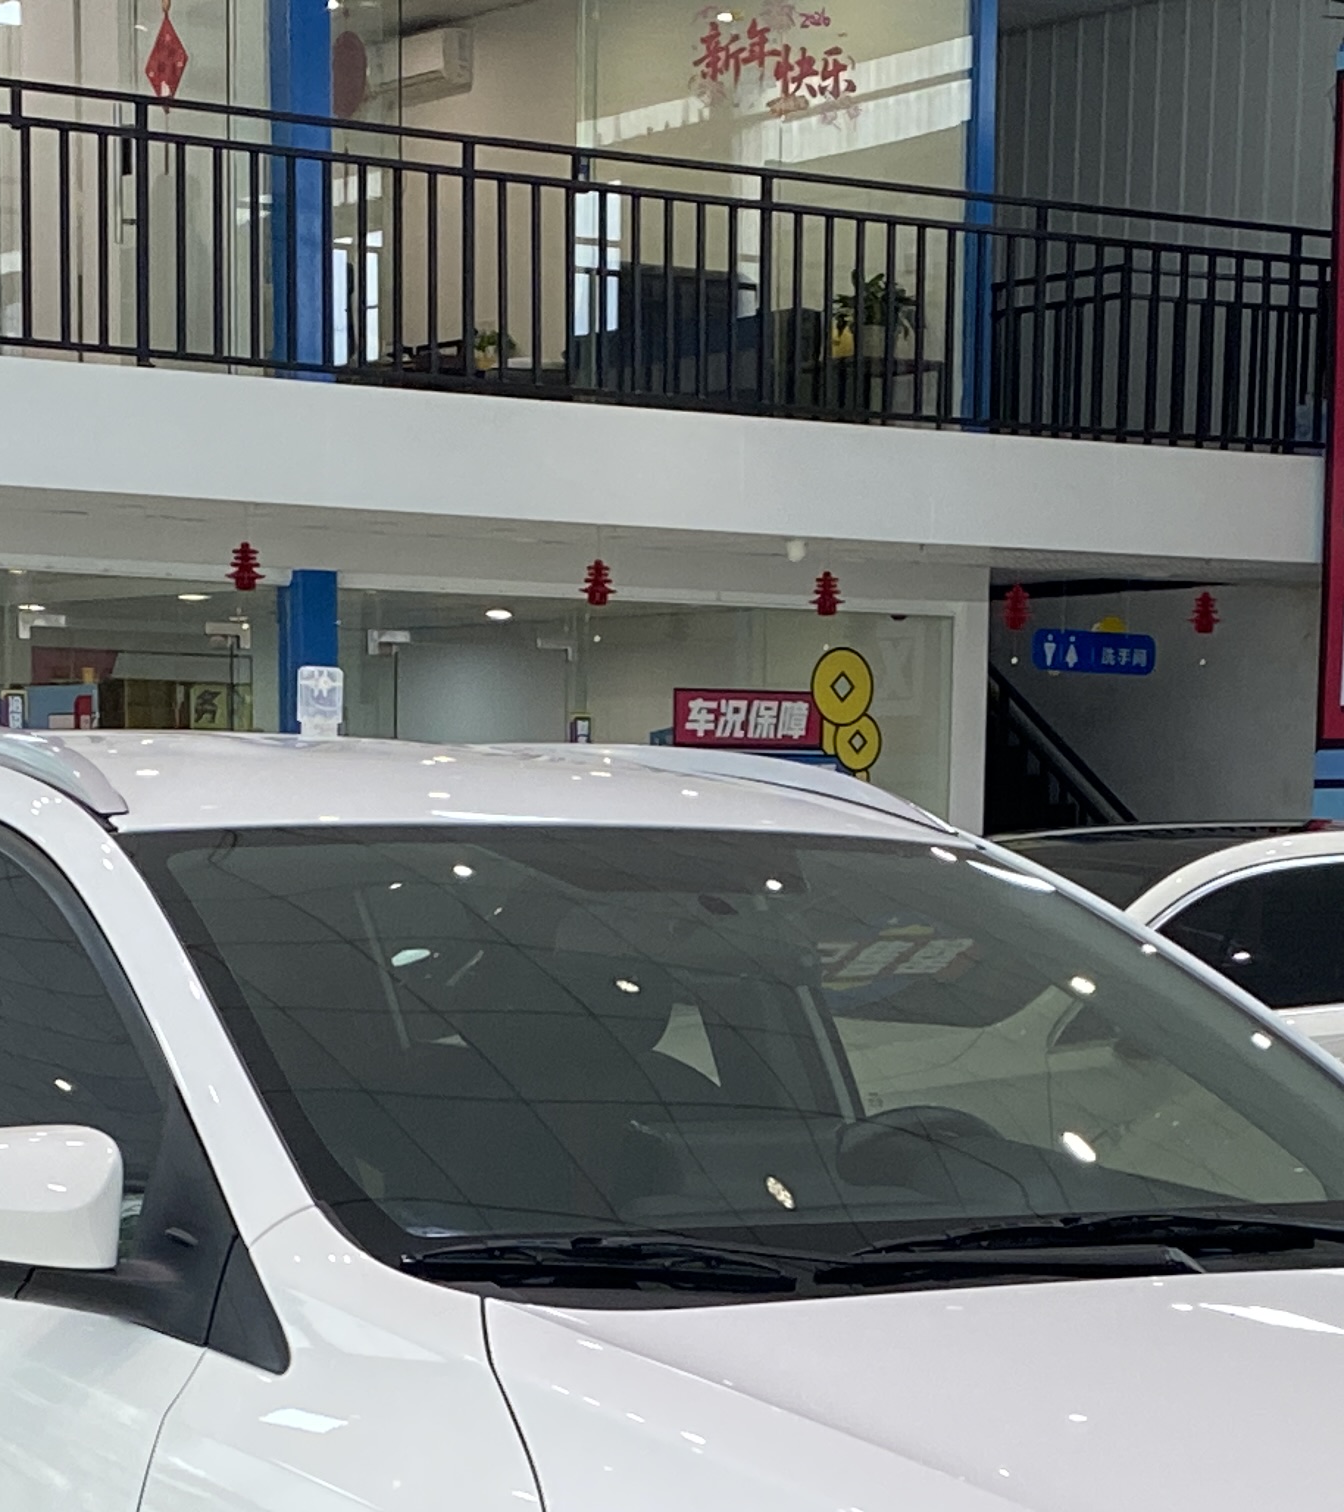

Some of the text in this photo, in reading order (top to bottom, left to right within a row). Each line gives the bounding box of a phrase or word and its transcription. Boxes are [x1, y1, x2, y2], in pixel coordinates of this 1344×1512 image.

[1101, 646, 1148, 667] 洗手间
[685, 698, 810, 740] 车况保障
